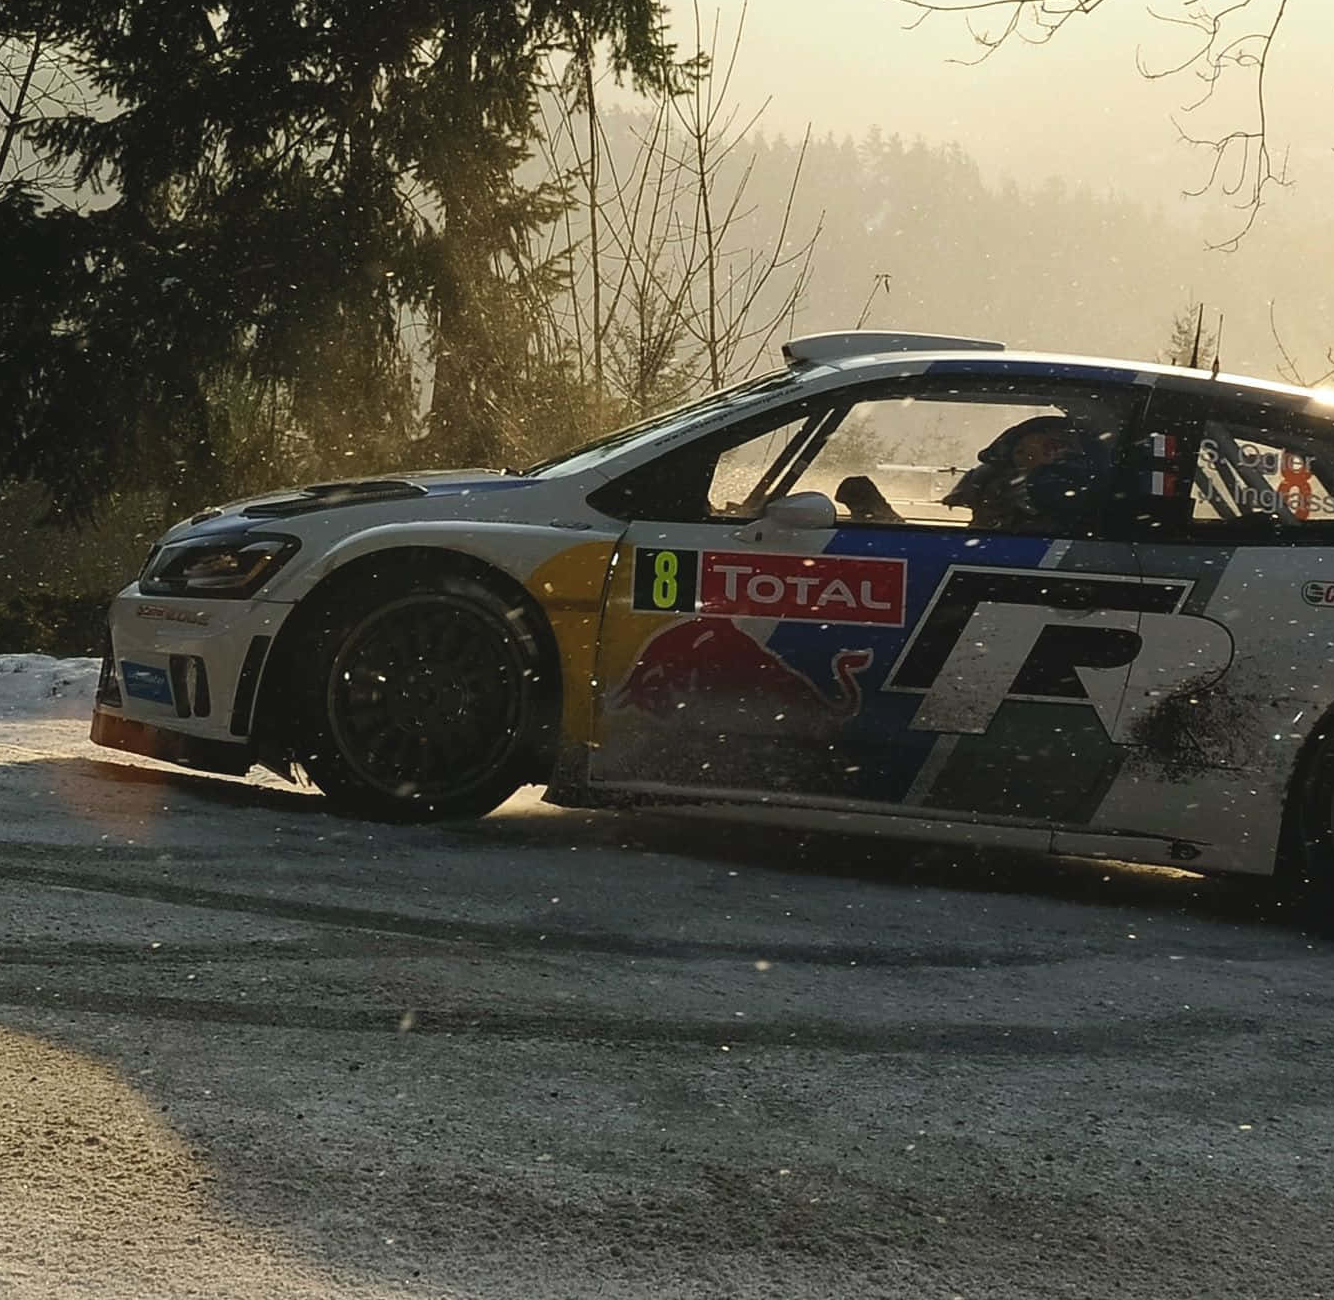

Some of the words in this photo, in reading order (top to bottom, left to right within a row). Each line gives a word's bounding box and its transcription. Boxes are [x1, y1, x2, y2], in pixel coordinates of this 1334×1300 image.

[1199, 438, 1220, 469] S.
[1238, 443, 1316, 476] Ogier
[653, 551, 678, 608] 8
[713, 565, 892, 610] TOTAL
[908, 600, 1235, 745] R
